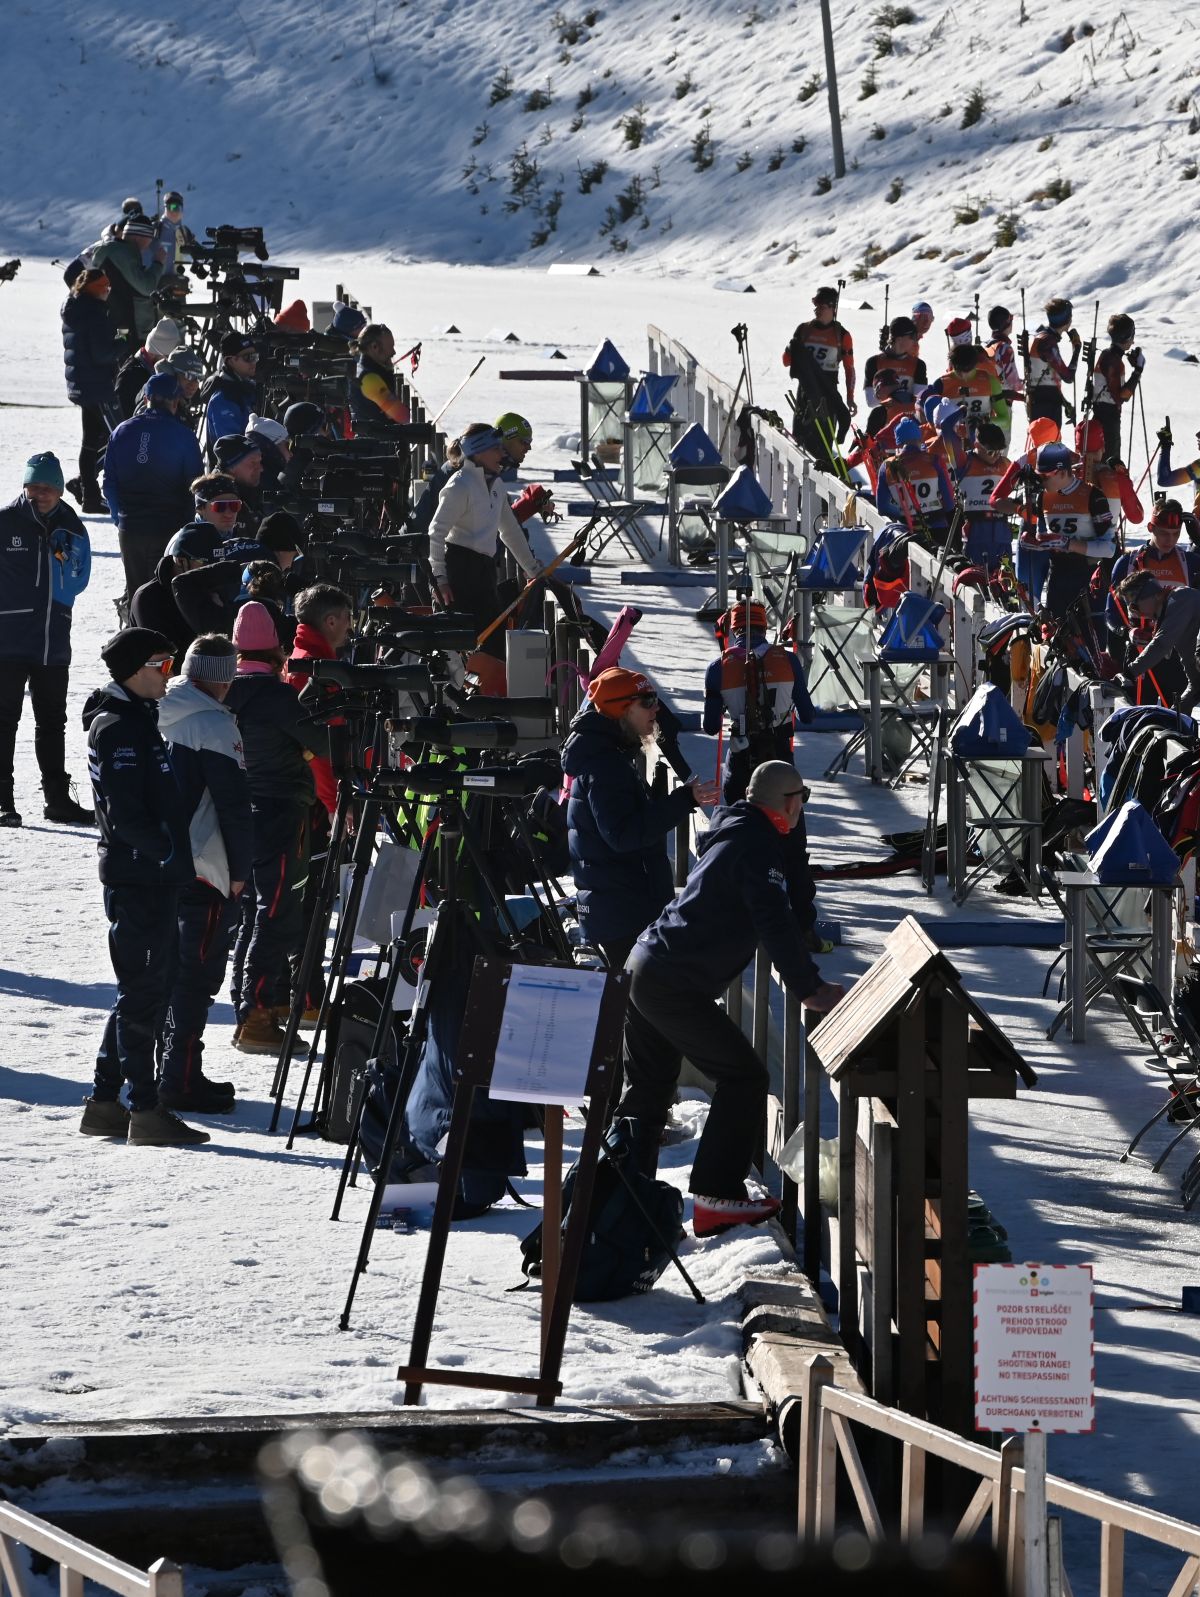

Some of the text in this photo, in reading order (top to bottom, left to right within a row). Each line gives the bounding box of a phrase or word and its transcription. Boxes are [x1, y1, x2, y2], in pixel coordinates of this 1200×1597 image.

[1050, 518, 1078, 533] 65
[997, 1305, 1024, 1313] POZOR
[1001, 1317, 1067, 1326] PREHOD STROGO
[1006, 1327, 1062, 1335] PREPOVEDAN!
[1012, 1351, 1056, 1359] ATTENTION
[998, 1360, 1071, 1368] SHOOTING RANGE!
[1012, 1372, 1069, 1380] TRESPASSING!
[981, 1395, 1020, 1403] ACHTUNG
[986, 1408, 1083, 1418] DURCHGANG VERBOTEN!
